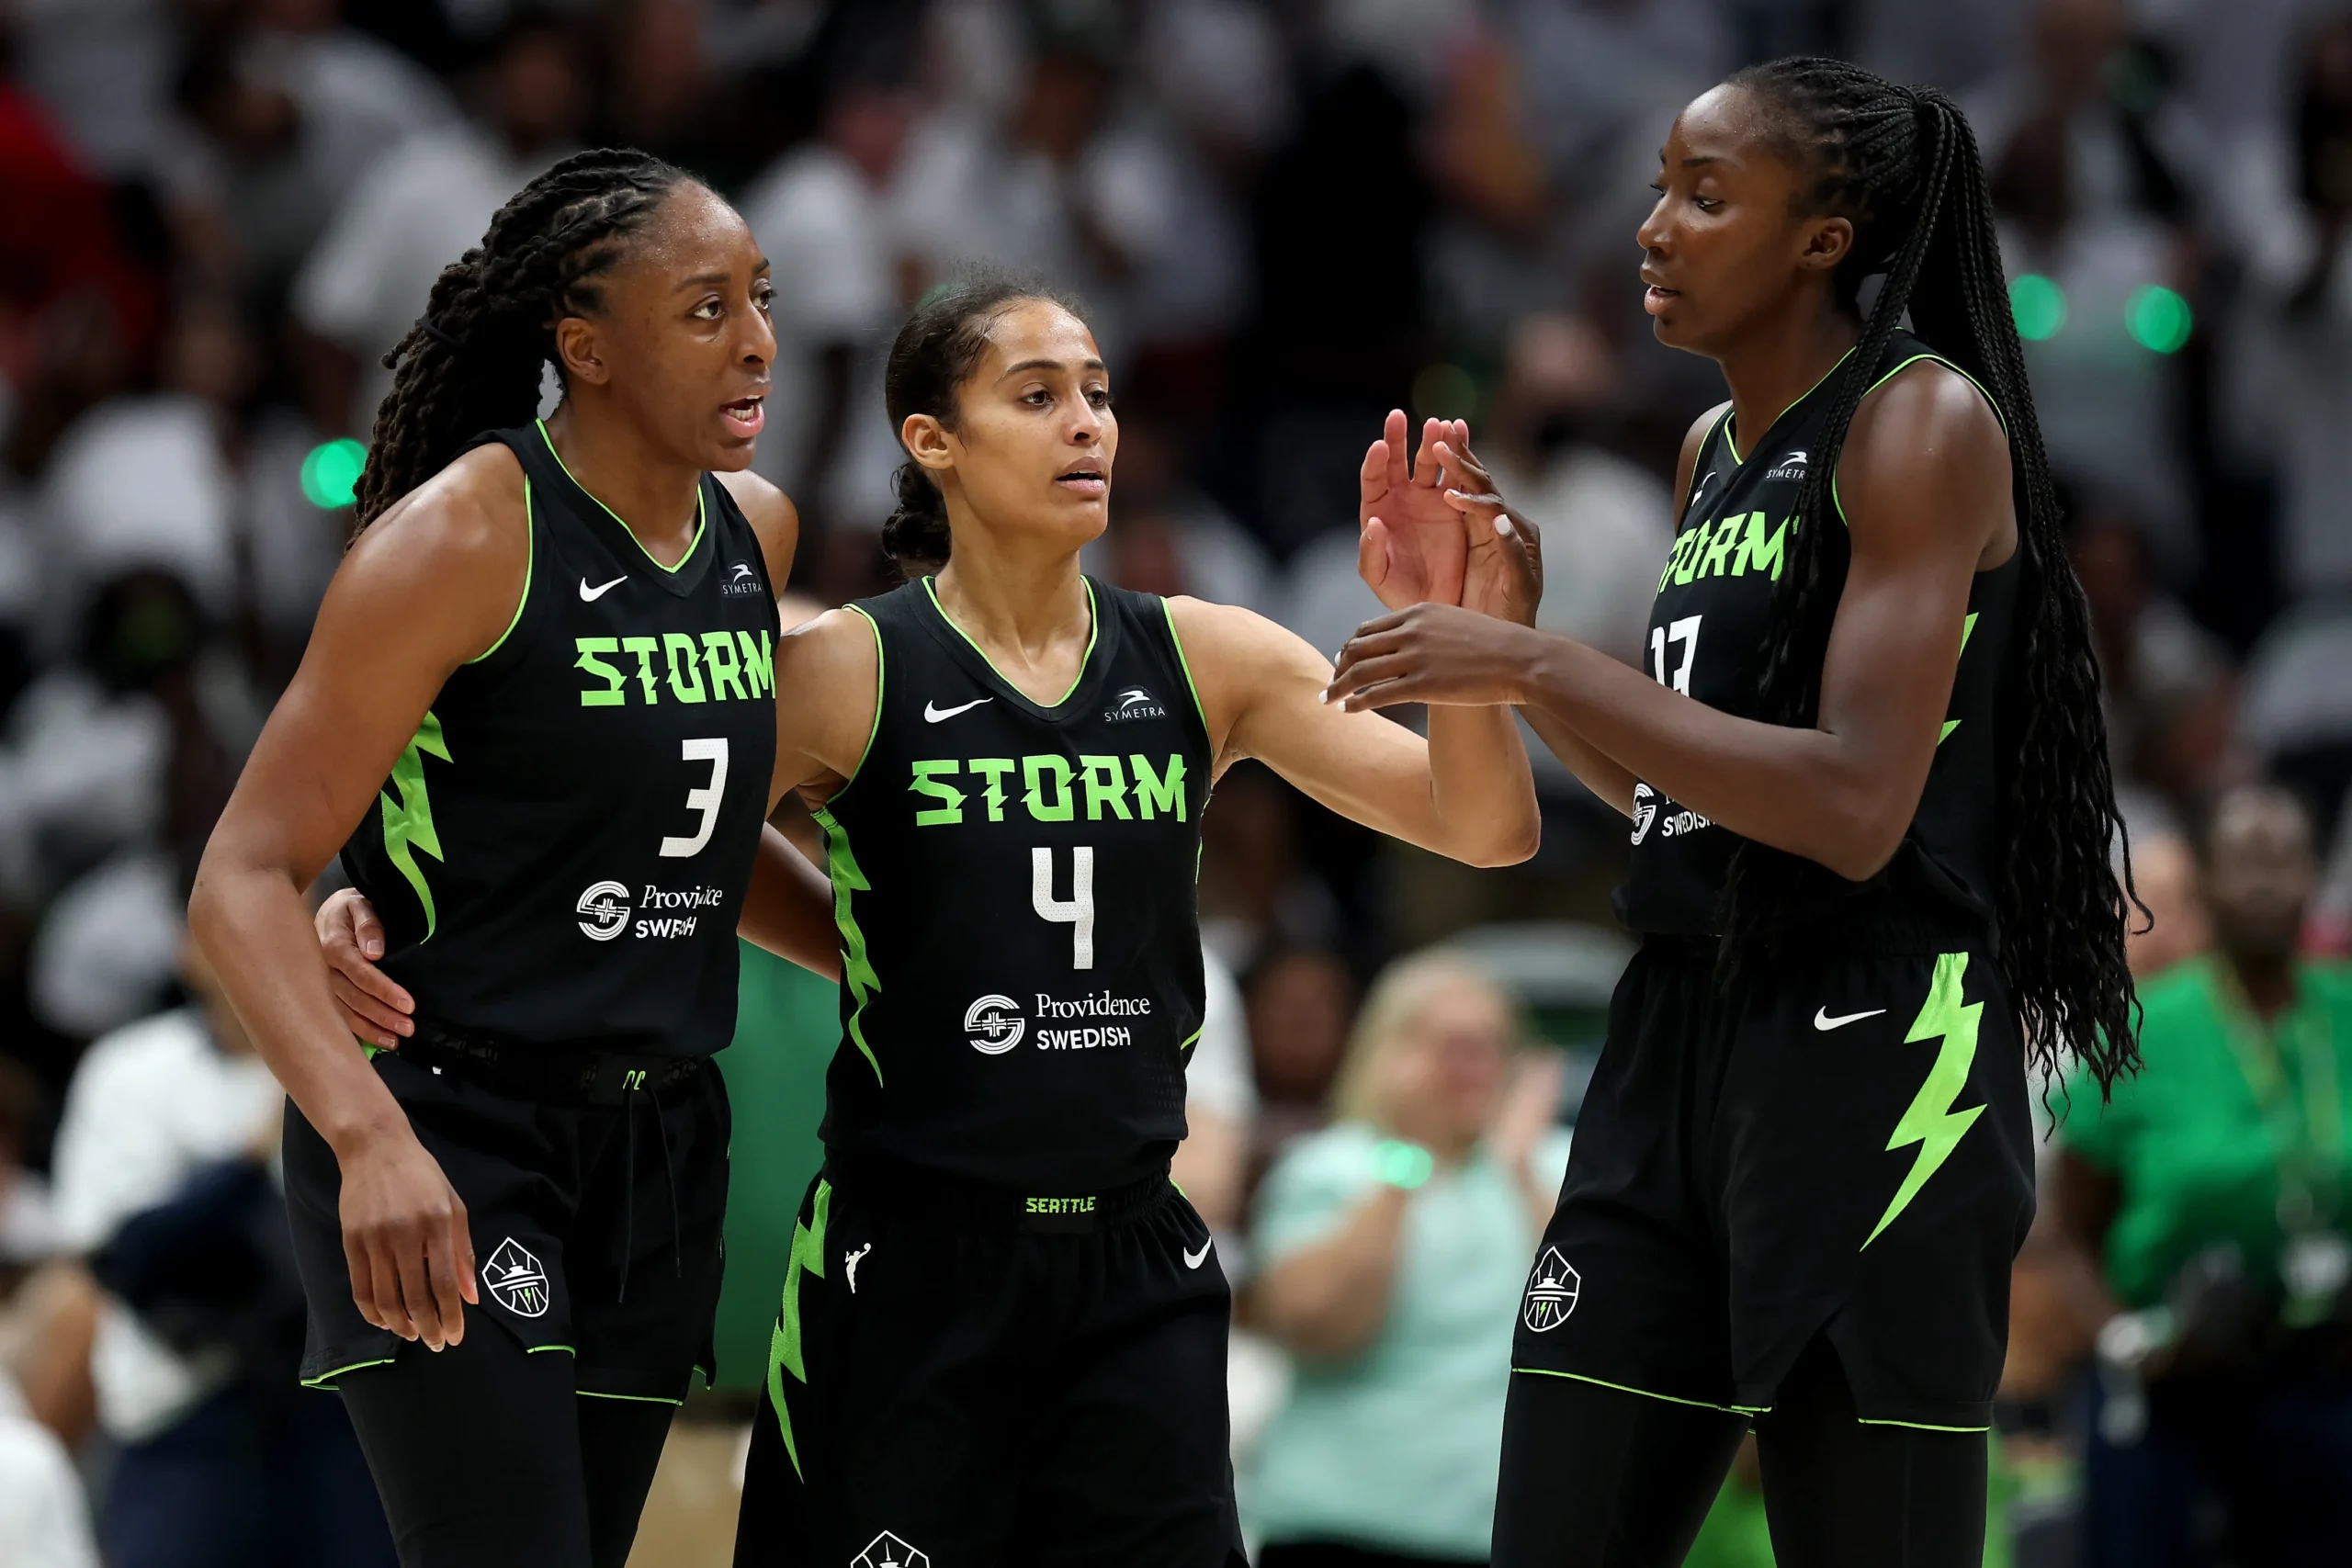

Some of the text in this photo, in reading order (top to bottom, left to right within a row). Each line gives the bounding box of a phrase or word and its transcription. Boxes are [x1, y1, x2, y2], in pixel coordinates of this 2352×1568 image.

[1765, 468, 1805, 479] SYMETR
[1654, 511, 1800, 602] TORM
[722, 582, 763, 595] SYMETRA
[573, 629, 776, 706] STORM
[1651, 615, 1703, 698] 17
[1103, 706, 1166, 722] SYMETRA
[659, 737, 729, 858] 3
[908, 753, 1188, 827] STORM
[1661, 811, 1716, 837] SWEDIS
[1031, 846, 1094, 970] 4
[1035, 989, 1151, 1019] Providence
[1036, 1026, 1131, 1051] SWEDISH
[1025, 1196, 1096, 1213] SEATTLE
